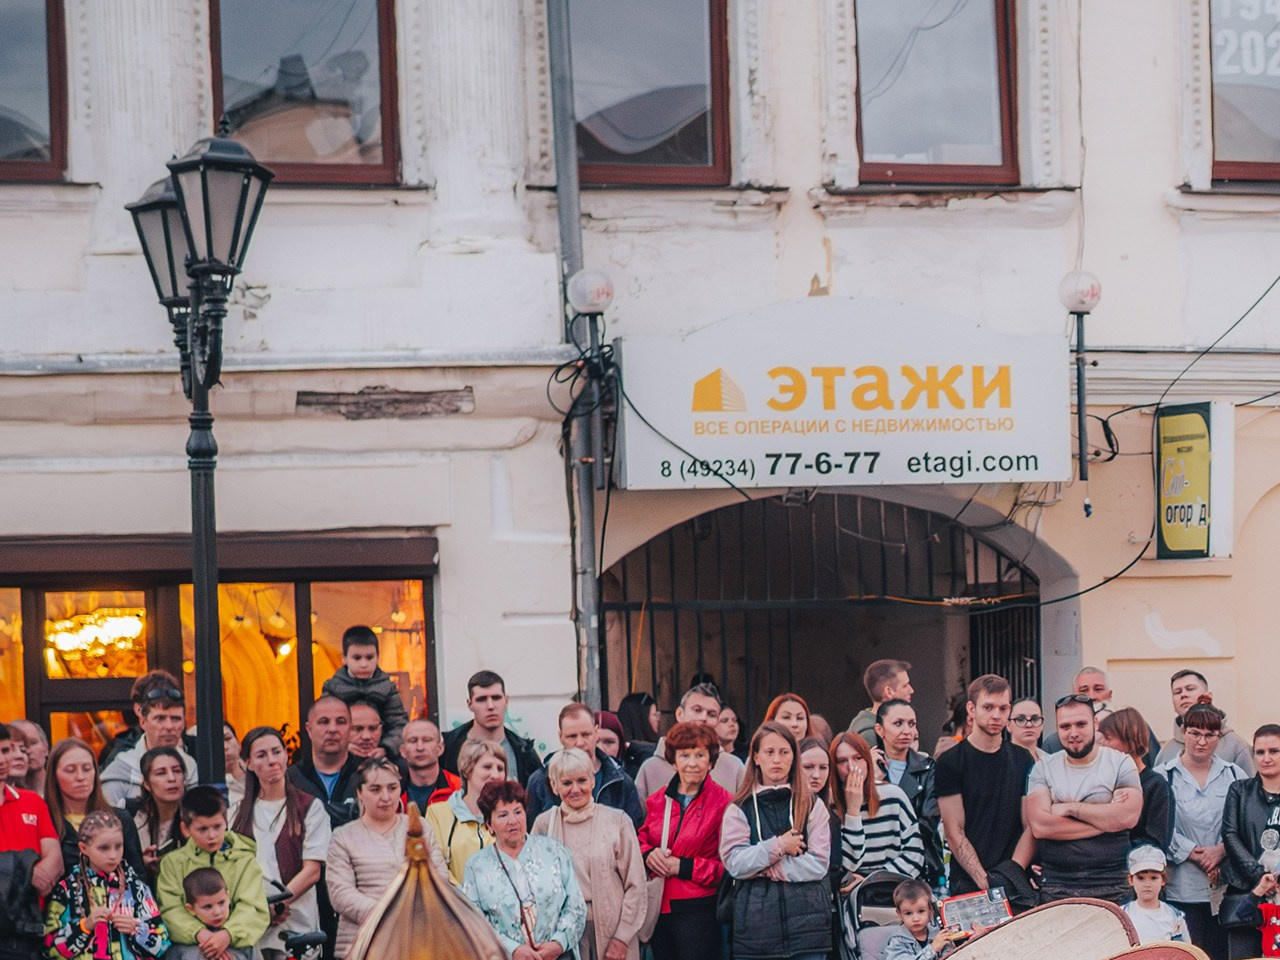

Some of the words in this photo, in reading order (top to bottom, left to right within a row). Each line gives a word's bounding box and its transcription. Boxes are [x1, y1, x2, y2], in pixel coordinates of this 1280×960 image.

[693, 420, 729, 435] ВСЕ
[735, 420, 829, 436] ОПЕРАЦИИ
[834, 420, 846, 433] С
[852, 417, 1013, 434] НЕДВИЖИМОСТЬЮ
[661, 460, 672, 477] 8
[680, 459, 755, 482] (49234)
[765, 452, 880, 475] 77-6-77
[907, 450, 1038, 478] etagi.com
[1166, 503, 1207, 529] огорд
